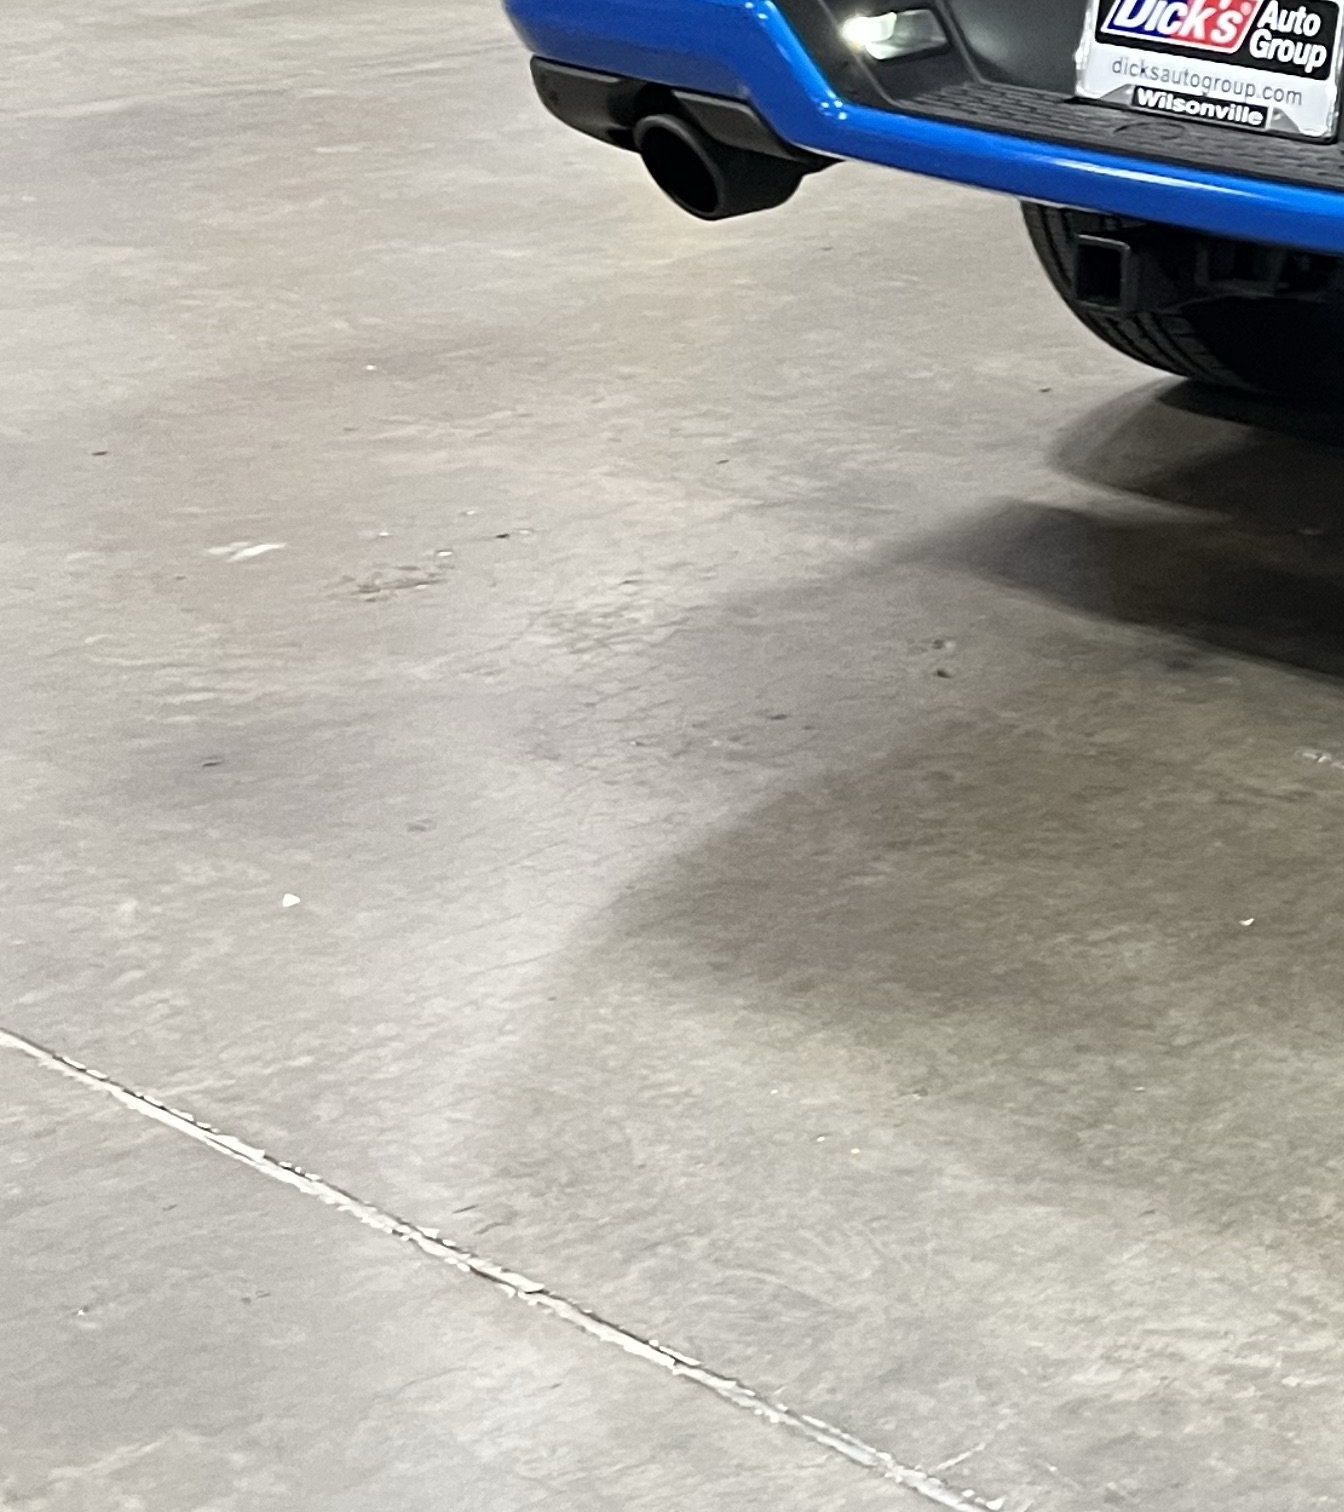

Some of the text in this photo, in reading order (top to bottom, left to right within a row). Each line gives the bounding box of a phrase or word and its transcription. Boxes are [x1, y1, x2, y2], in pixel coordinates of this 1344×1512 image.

[1256, 0, 1321, 37] Auto
[1249, 28, 1328, 74] Group
[1111, 56, 1304, 106] dicksautogroup.com
[1135, 87, 1265, 127] Wilsonville
